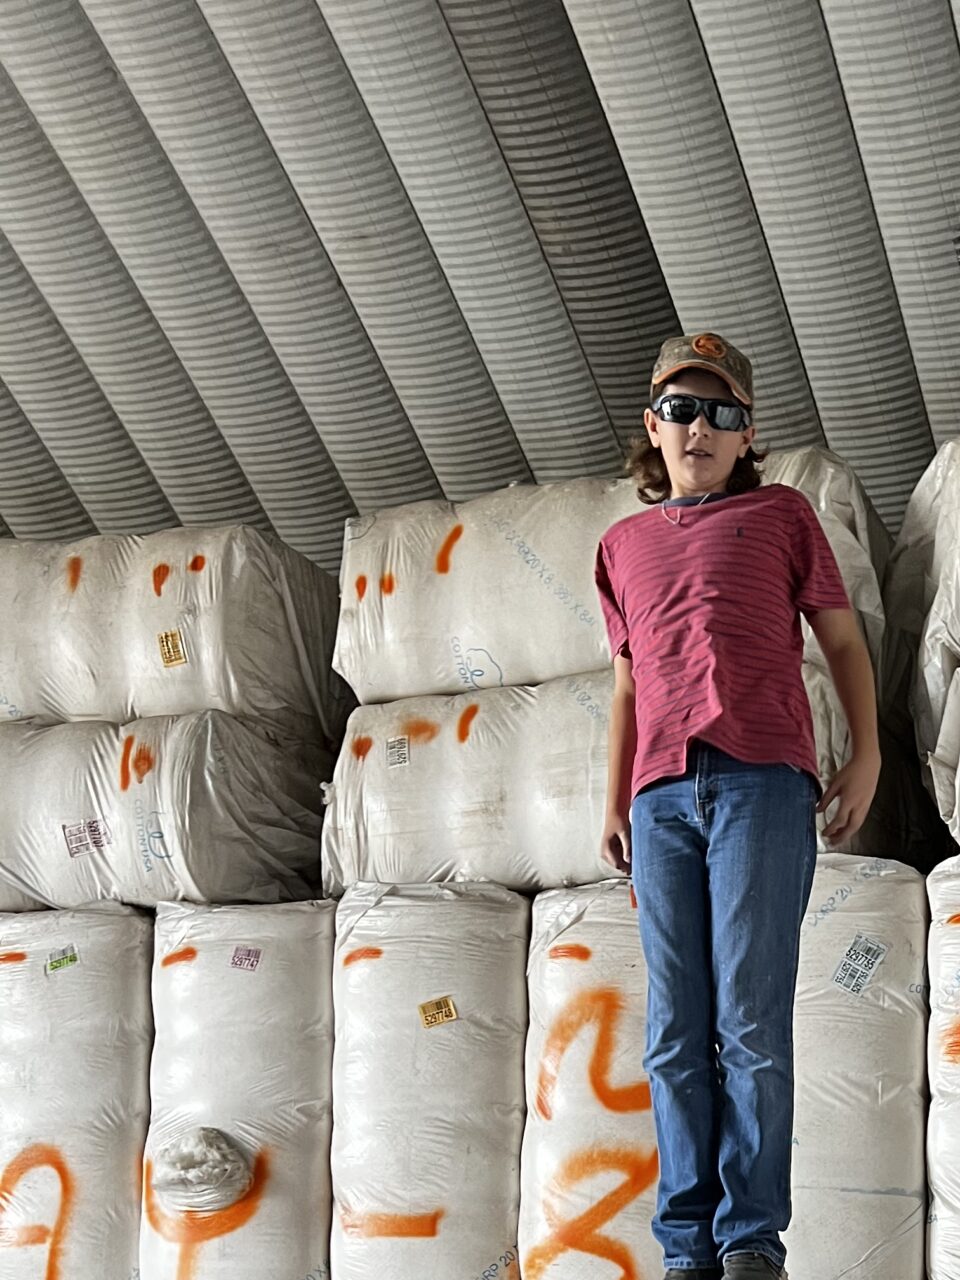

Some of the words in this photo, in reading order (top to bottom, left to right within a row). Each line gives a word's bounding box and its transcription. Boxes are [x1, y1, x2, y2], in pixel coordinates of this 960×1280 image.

[451, 635, 471, 685] COTTON
[134, 798, 147, 850] COTTON
[142, 851, 153, 873] USA
[231, 955, 260, 970] 5297747
[845, 947, 876, 971] 5297755
[424, 1007, 454, 1026] 5297748
[498, 1250, 515, 1269] 20
